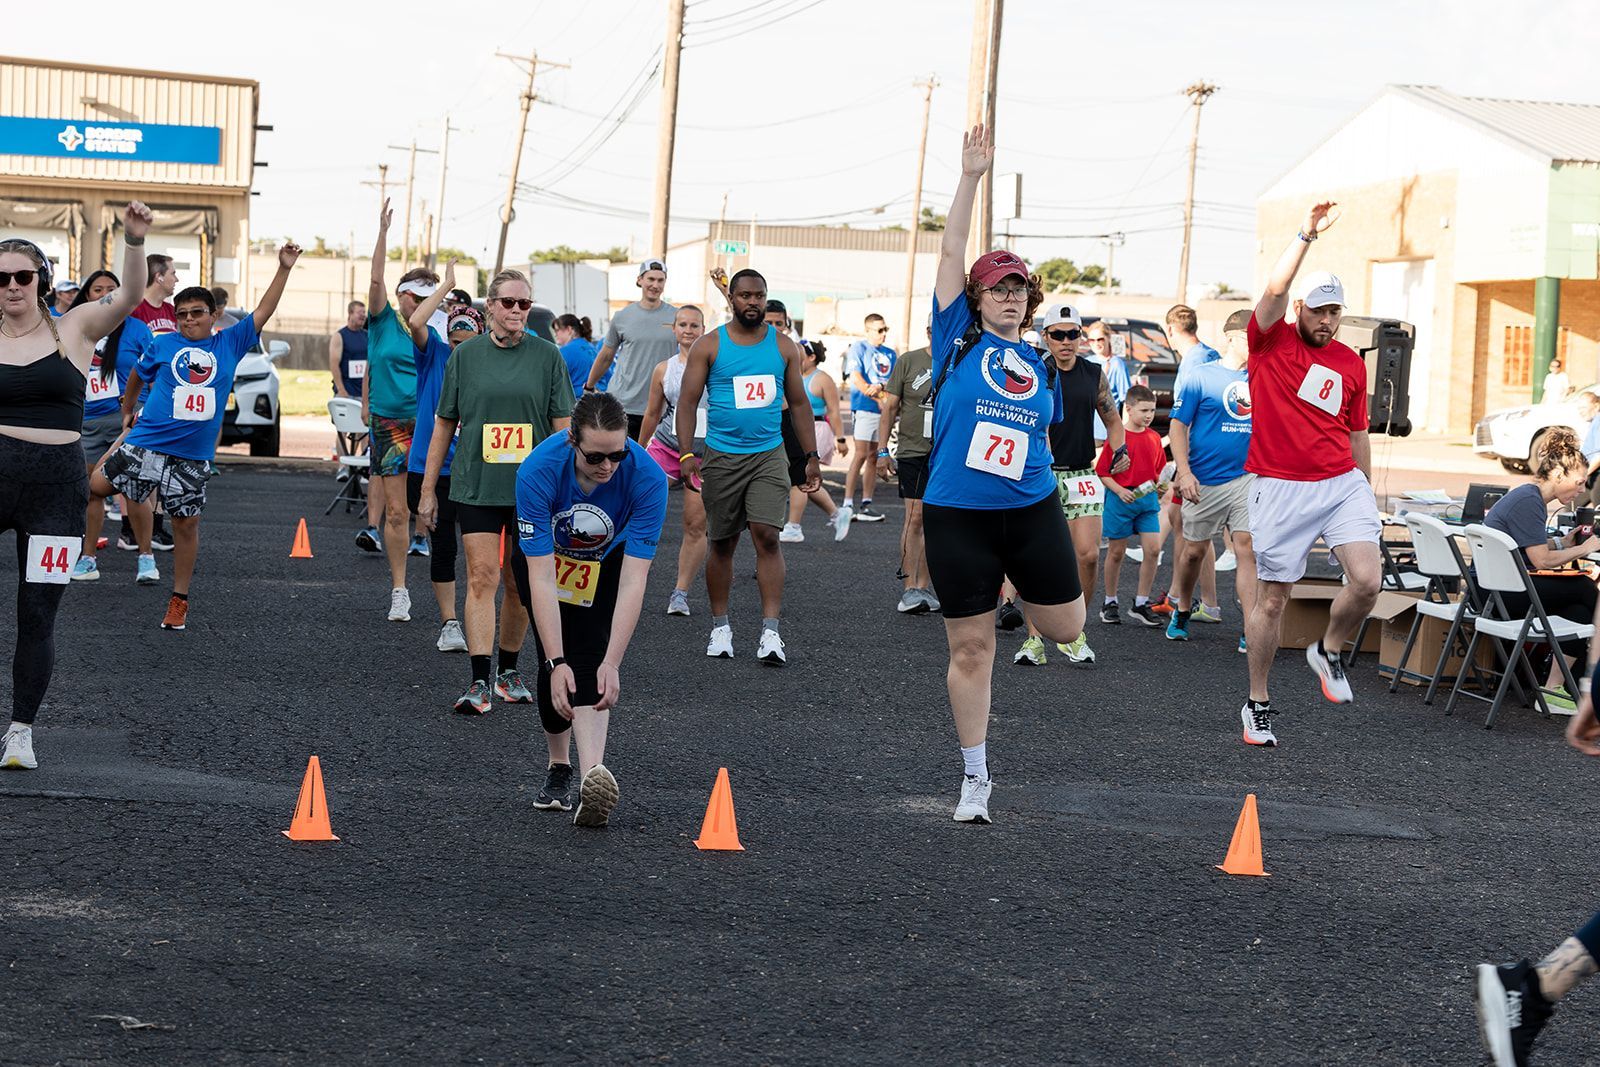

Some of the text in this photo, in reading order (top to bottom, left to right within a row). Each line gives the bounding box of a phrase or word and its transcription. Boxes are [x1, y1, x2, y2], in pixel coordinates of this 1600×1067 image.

[91, 377, 108, 394] 64
[745, 382, 766, 401] 24
[1319, 379, 1334, 400] 8
[185, 394, 205, 413] 49
[975, 405, 1038, 427] RUN+WALK
[491, 427, 525, 449] 371
[984, 434, 1015, 466] 73
[1078, 480, 1096, 496] 45
[41, 546, 69, 573] 44
